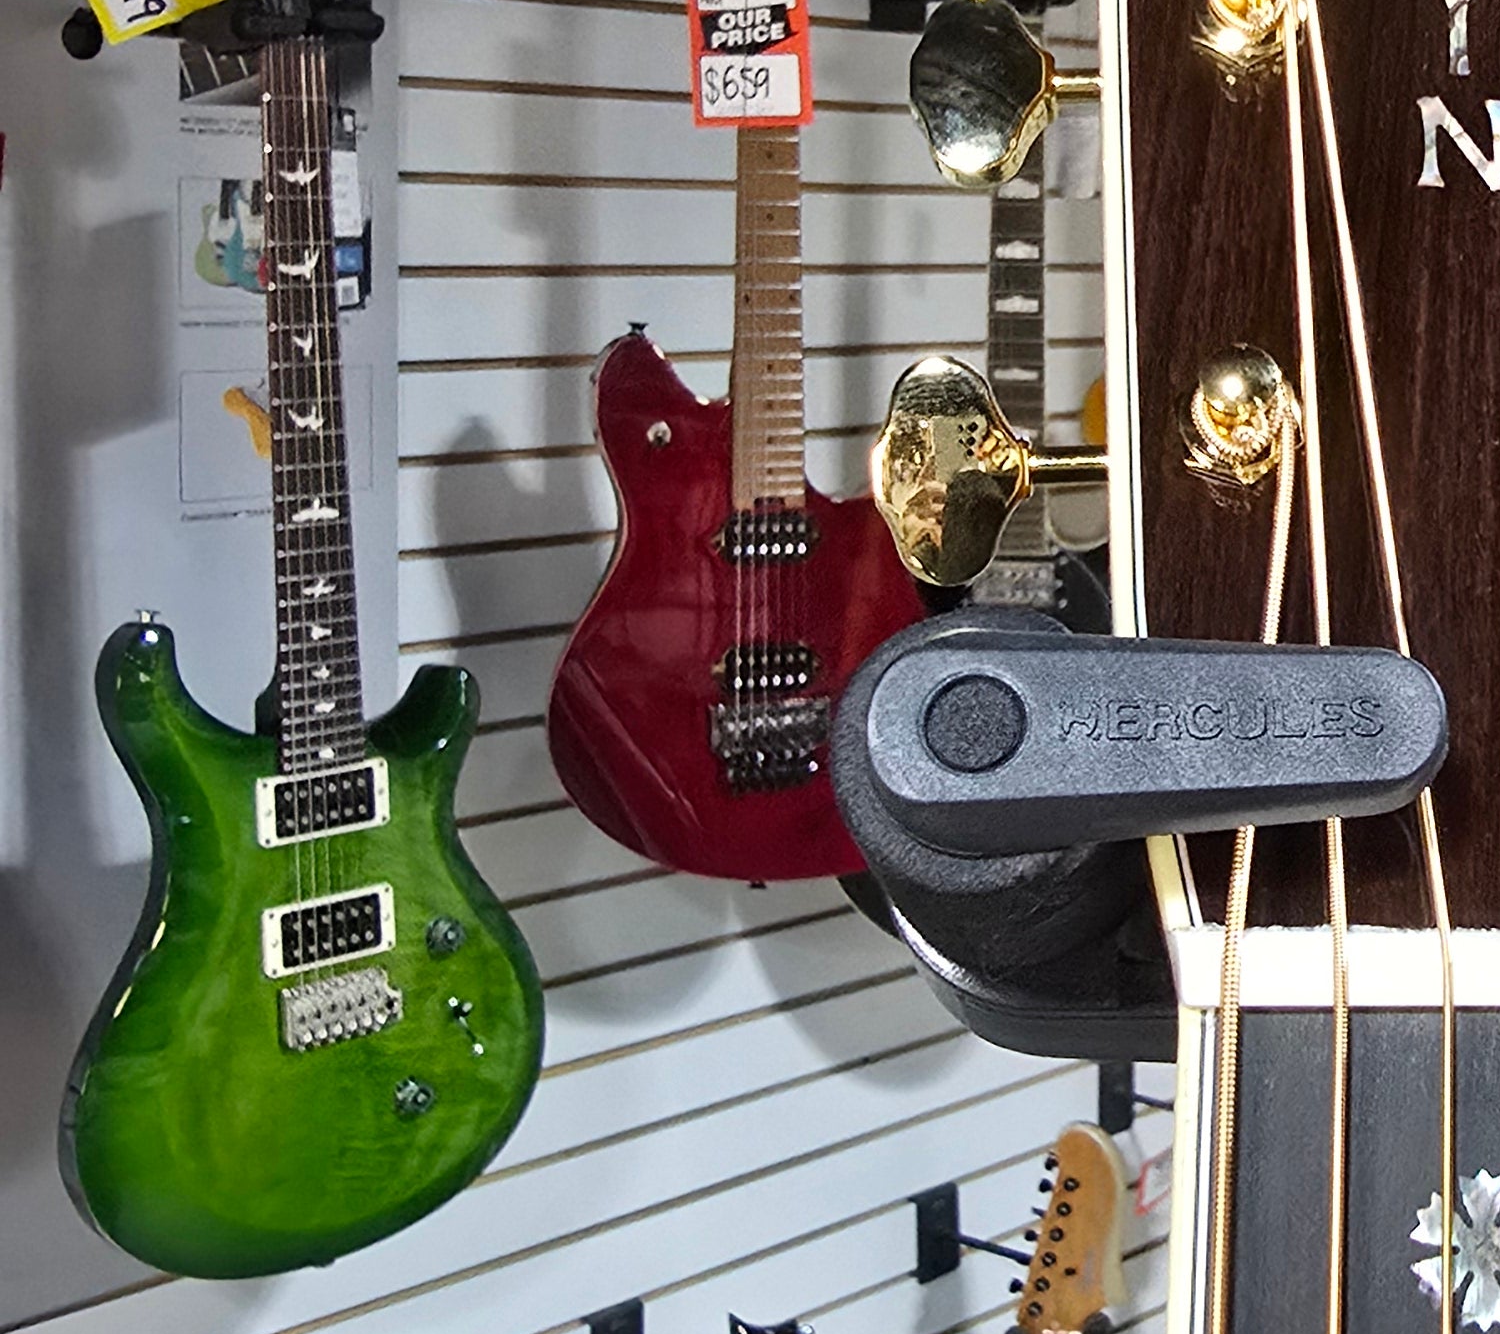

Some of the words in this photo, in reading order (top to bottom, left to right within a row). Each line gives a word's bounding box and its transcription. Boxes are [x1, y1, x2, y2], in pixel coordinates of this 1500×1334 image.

[718, 8, 771, 29] OUR
[711, 22, 786, 49] PRICE
[704, 65, 770, 105] $659
[1058, 694, 1386, 744] HERCULES
